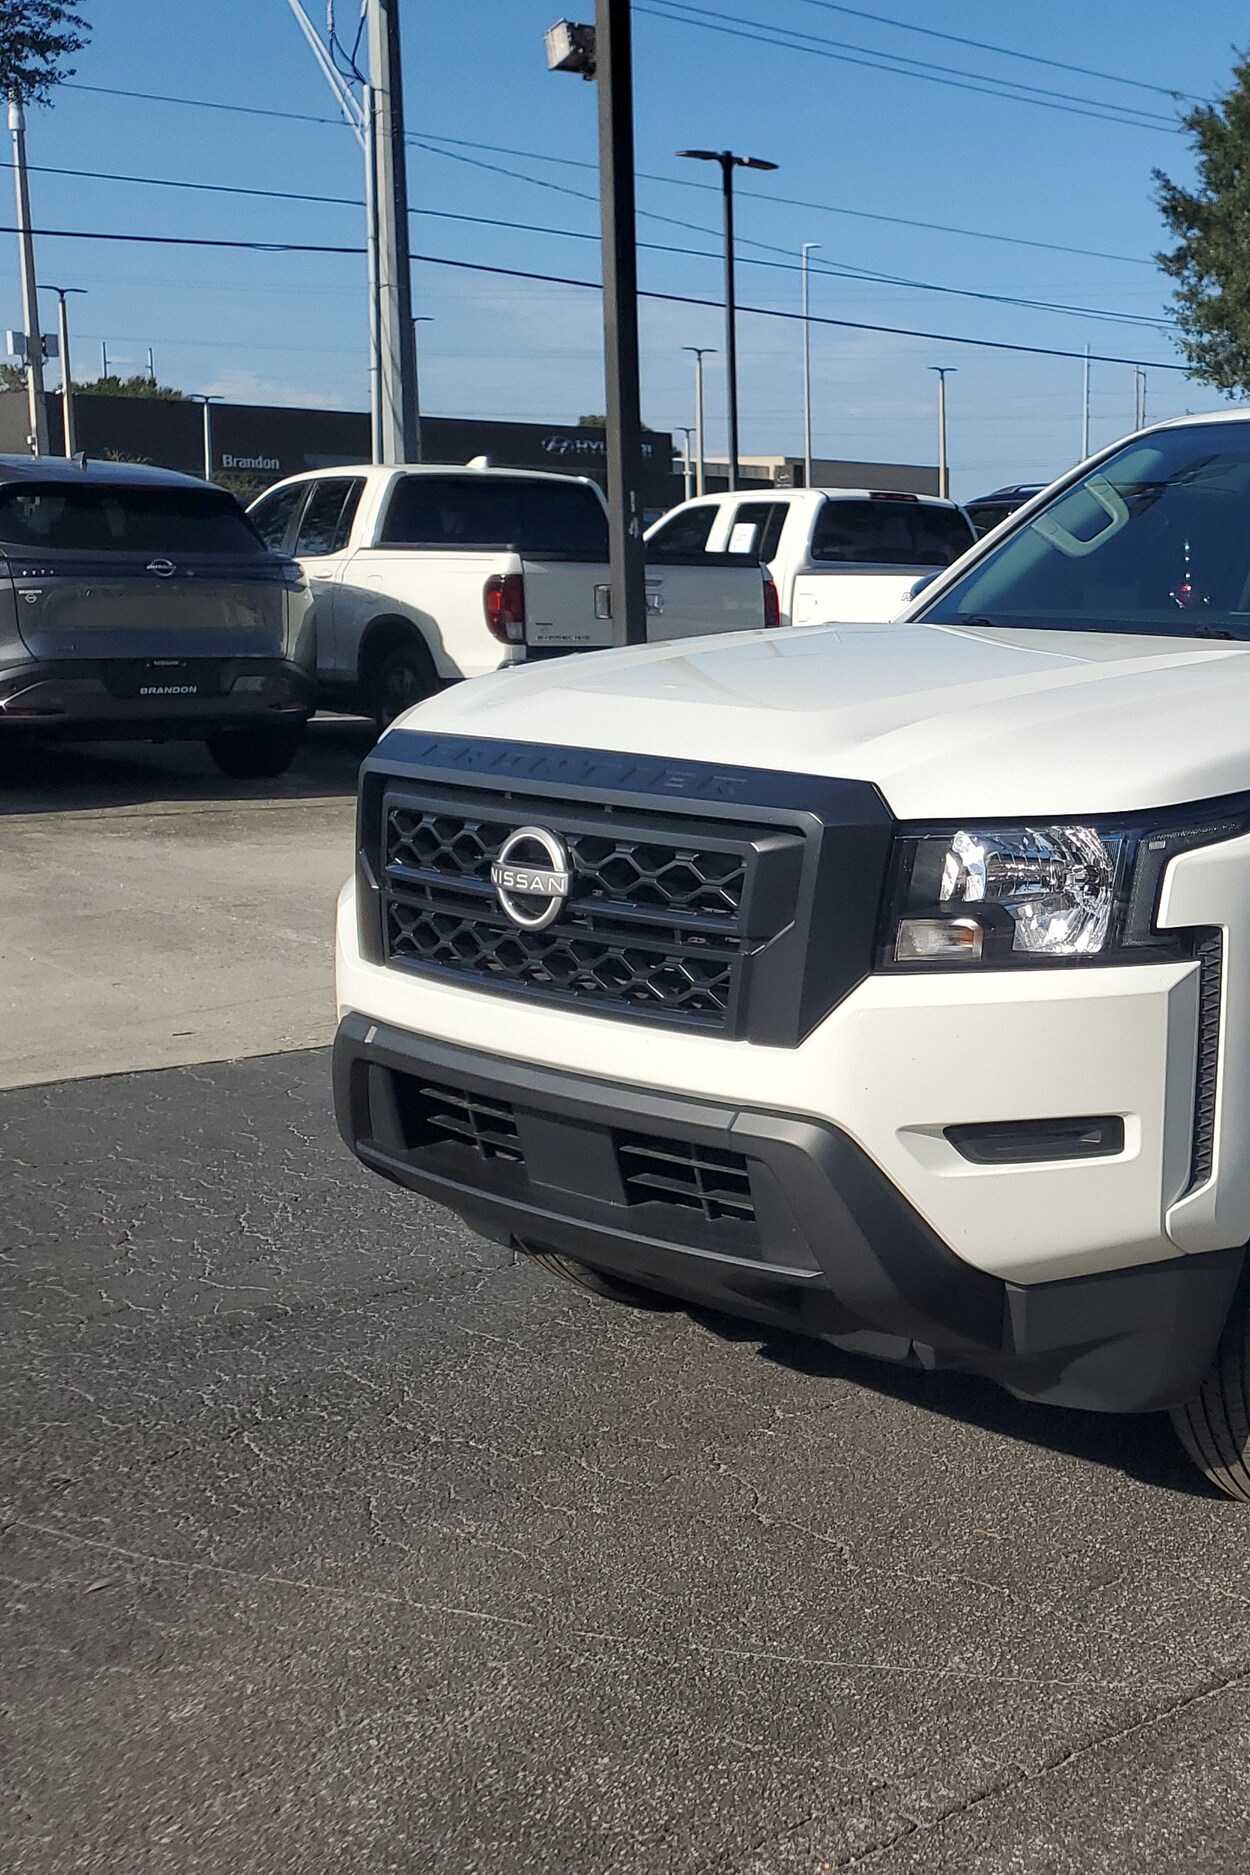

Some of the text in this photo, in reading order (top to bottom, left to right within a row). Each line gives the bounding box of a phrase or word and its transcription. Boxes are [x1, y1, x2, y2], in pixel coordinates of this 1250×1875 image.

[222, 453, 280, 470] Brandon
[139, 685, 198, 696] BRANDON
[490, 866, 566, 893] NISSAN
